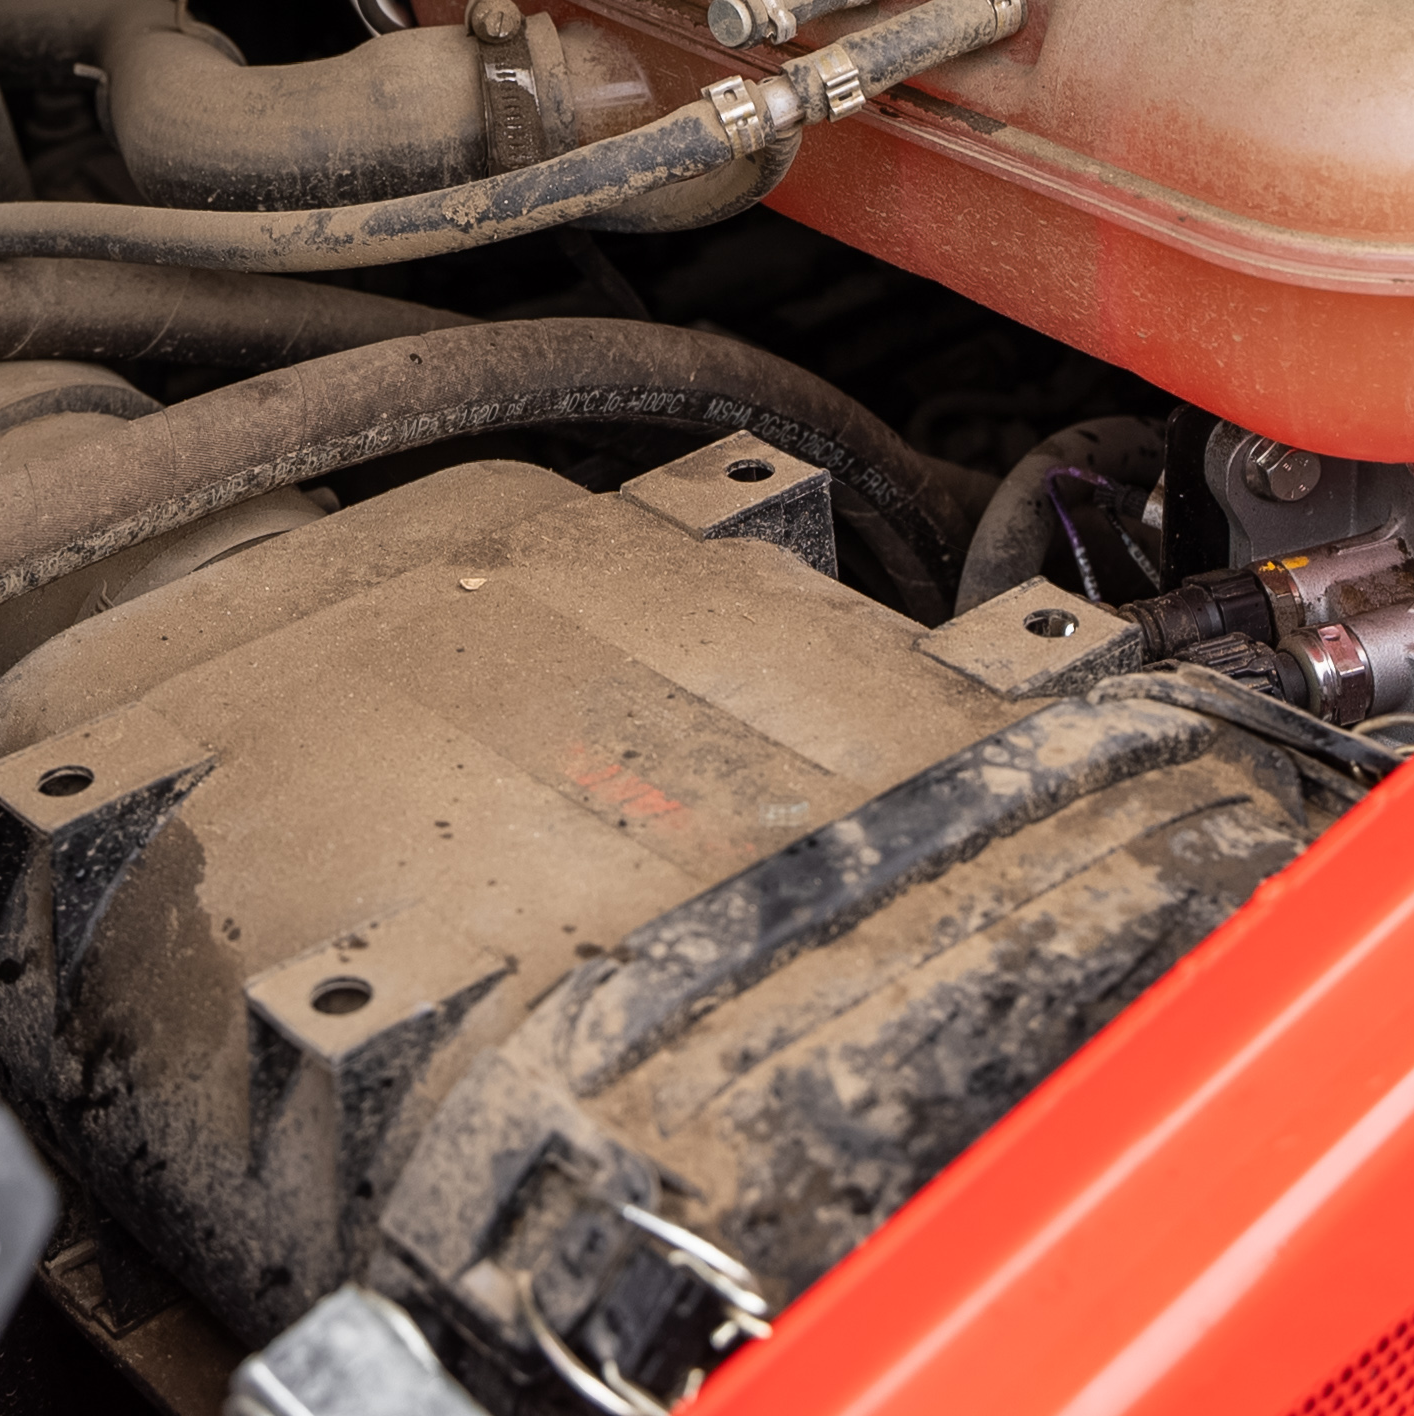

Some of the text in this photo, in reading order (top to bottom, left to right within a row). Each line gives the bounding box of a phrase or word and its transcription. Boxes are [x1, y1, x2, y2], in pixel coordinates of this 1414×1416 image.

[459, 402, 500, 430] 1520
[703, 397, 753, 428] MSHA
[857, 467, 898, 506] FRAS
